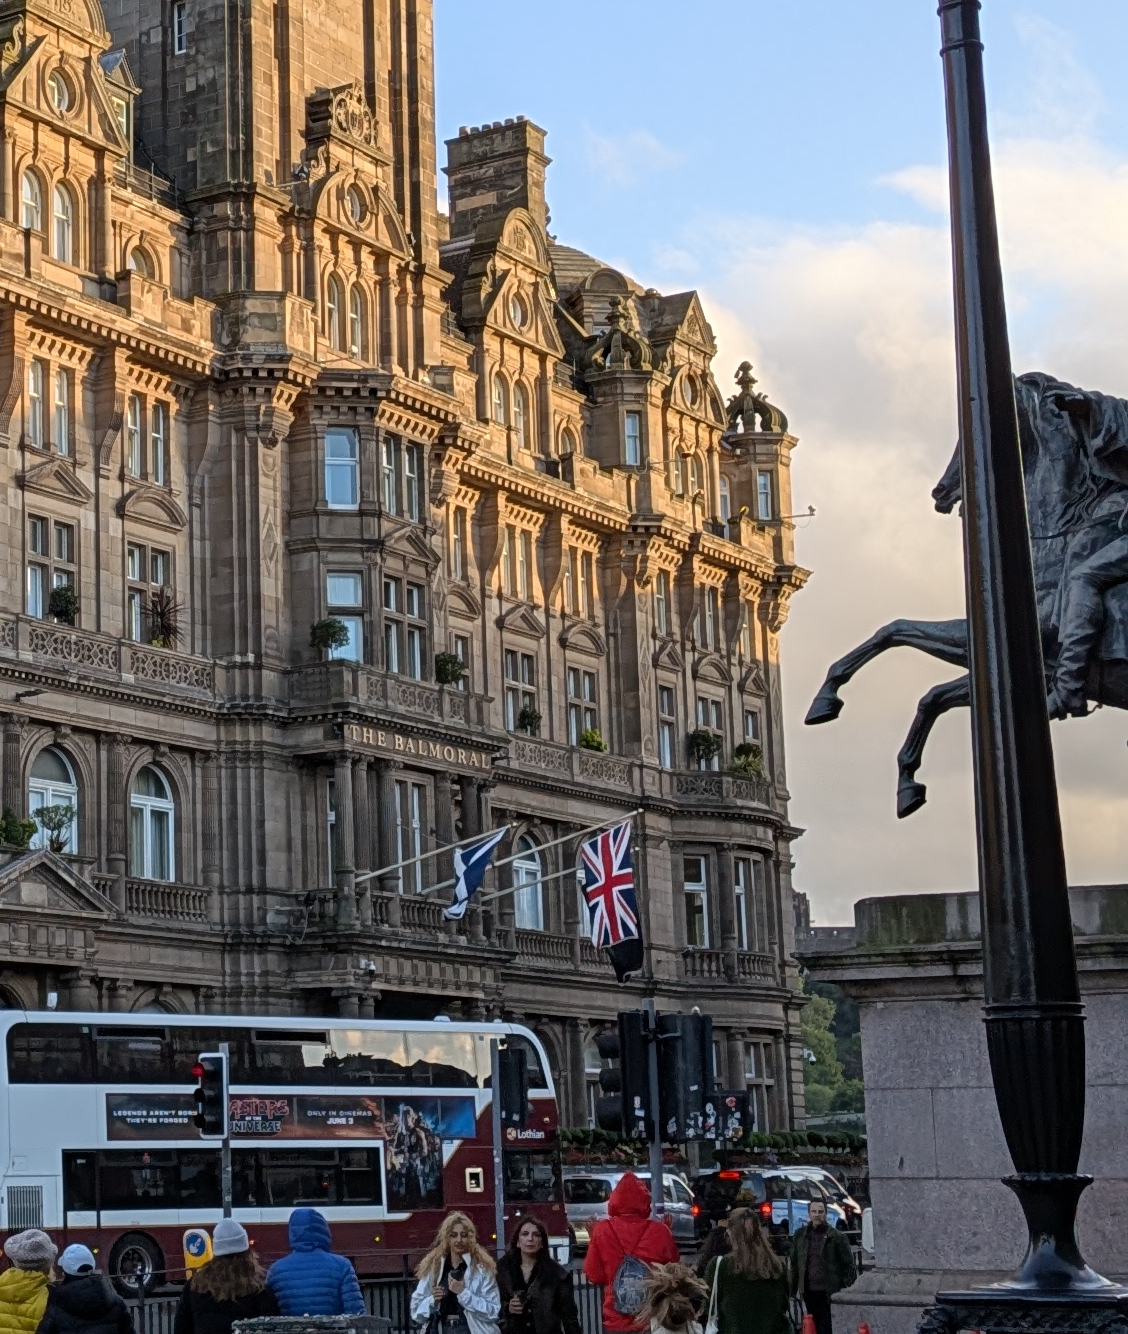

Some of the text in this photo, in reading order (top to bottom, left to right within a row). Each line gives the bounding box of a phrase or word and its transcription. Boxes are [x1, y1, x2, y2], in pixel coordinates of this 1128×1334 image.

[349, 725, 490, 769] THE BALMORAL
[229, 1099, 290, 1120] ASTERS
[326, 1117, 347, 1125] JUNE
[517, 1129, 545, 1139] Lothian
